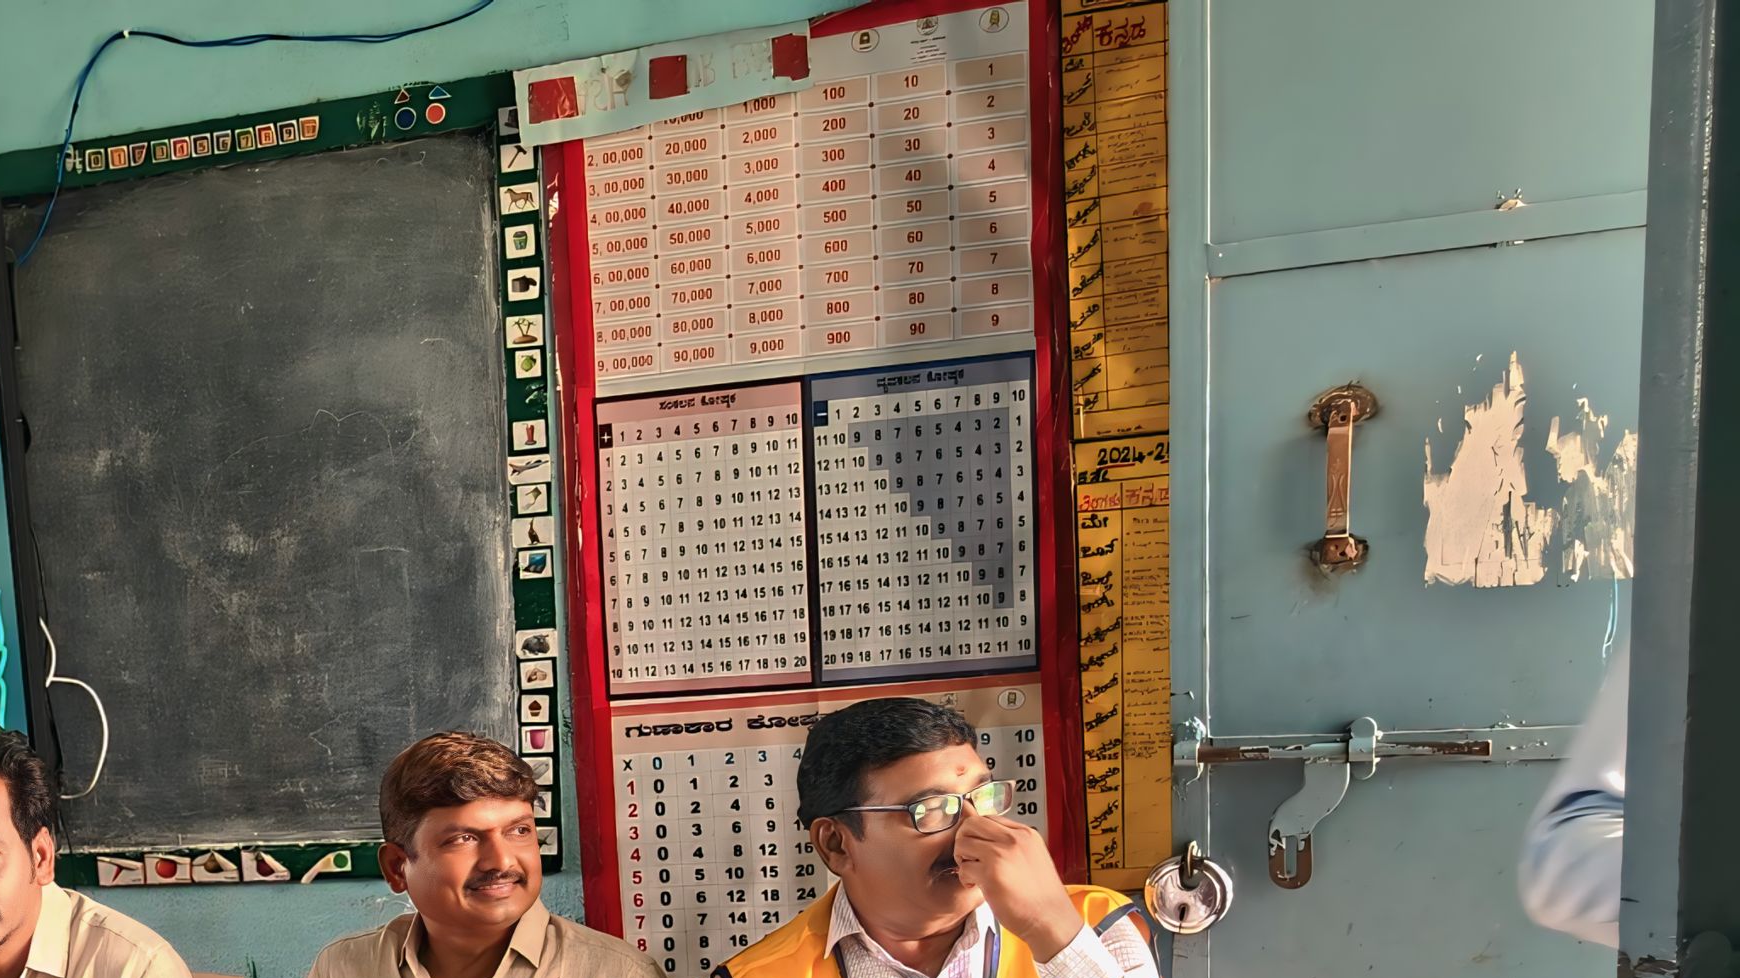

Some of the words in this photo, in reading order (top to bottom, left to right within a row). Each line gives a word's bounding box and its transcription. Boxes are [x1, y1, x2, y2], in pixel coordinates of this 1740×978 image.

[822, 86, 846, 101] 100
[904, 74, 919, 88] 10
[988, 63, 994, 76] 1
[665, 138, 707, 156] 20,000
[742, 127, 777, 144] 2,000
[822, 117, 846, 132] 200
[903, 106, 920, 121] 20
[986, 95, 995, 108] 2
[666, 168, 708, 185] 30,000
[744, 157, 779, 174] 3,000
[822, 148, 845, 162] 300
[904, 138, 921, 152] 30
[987, 126, 995, 140] 3
[667, 198, 710, 214] 40,000
[744, 188, 779, 203] 4,000
[822, 178, 846, 193] 400
[905, 169, 922, 182] 40
[987, 158, 996, 171] 4
[669, 228, 711, 245] 50,000
[746, 218, 780, 234] 5,000
[823, 209, 847, 224] 500
[906, 199, 922, 213] 50
[988, 190, 997, 203] 5
[670, 258, 712, 275] 60,000
[746, 249, 781, 264] 6,000
[824, 239, 848, 254] 600
[906, 230, 923, 244] 60
[989, 221, 998, 234] 6
[671, 287, 713, 304] 70,000
[748, 279, 782, 295] 7,000
[825, 270, 849, 284] 700
[908, 260, 924, 274] 70
[990, 252, 998, 265] 7
[672, 317, 714, 334] 80,000
[748, 309, 784, 325] 8,000
[826, 300, 850, 315] 800
[908, 291, 925, 305] 80
[991, 283, 999, 295] 8
[673, 346, 715, 363] 90,000
[749, 338, 784, 354] 9,000
[827, 330, 851, 345] 900
[909, 322, 926, 336] 90
[991, 313, 1000, 327] 9
[611, 668, 623, 680] 10
[628, 666, 639, 678] 11
[645, 665, 657, 677] 12
[664, 664, 676, 676] 13
[682, 663, 695, 675] 14
[701, 661, 714, 673] 15
[720, 660, 732, 672] 16
[738, 658, 751, 671] 17
[756, 658, 769, 669] 18
[774, 656, 787, 669] 19
[793, 655, 807, 668] 20
[824, 654, 837, 665] 20
[840, 651, 854, 664] 19
[858, 650, 871, 662] 18
[879, 648, 892, 661] 17
[899, 647, 912, 660] 16
[919, 646, 932, 658] 15
[938, 644, 952, 657] 14
[958, 643, 971, 655] 13
[977, 641, 991, 654] 12
[996, 640, 1008, 653] 11
[1018, 638, 1031, 651] 10
[625, 716, 733, 739] ಗುಣಾಕಾರ
[626, 780, 635, 796] 1
[653, 778, 665, 794] 0
[689, 777, 698, 791] 1
[729, 775, 739, 788] 2
[764, 773, 774, 787] 3
[986, 757, 996, 770] 9
[1016, 753, 1036, 768] 10
[628, 803, 639, 818] 2
[654, 801, 666, 817] 0
[690, 800, 701, 814] 2
[730, 798, 741, 812] 4
[765, 797, 775, 810] 6
[1016, 778, 1037, 793] 20
[632, 870, 643, 885] 5
[658, 868, 671, 884] 0
[694, 868, 706, 881] 5
[724, 866, 745, 880] 10
[760, 865, 779, 879] 15
[795, 863, 815, 878] 20
